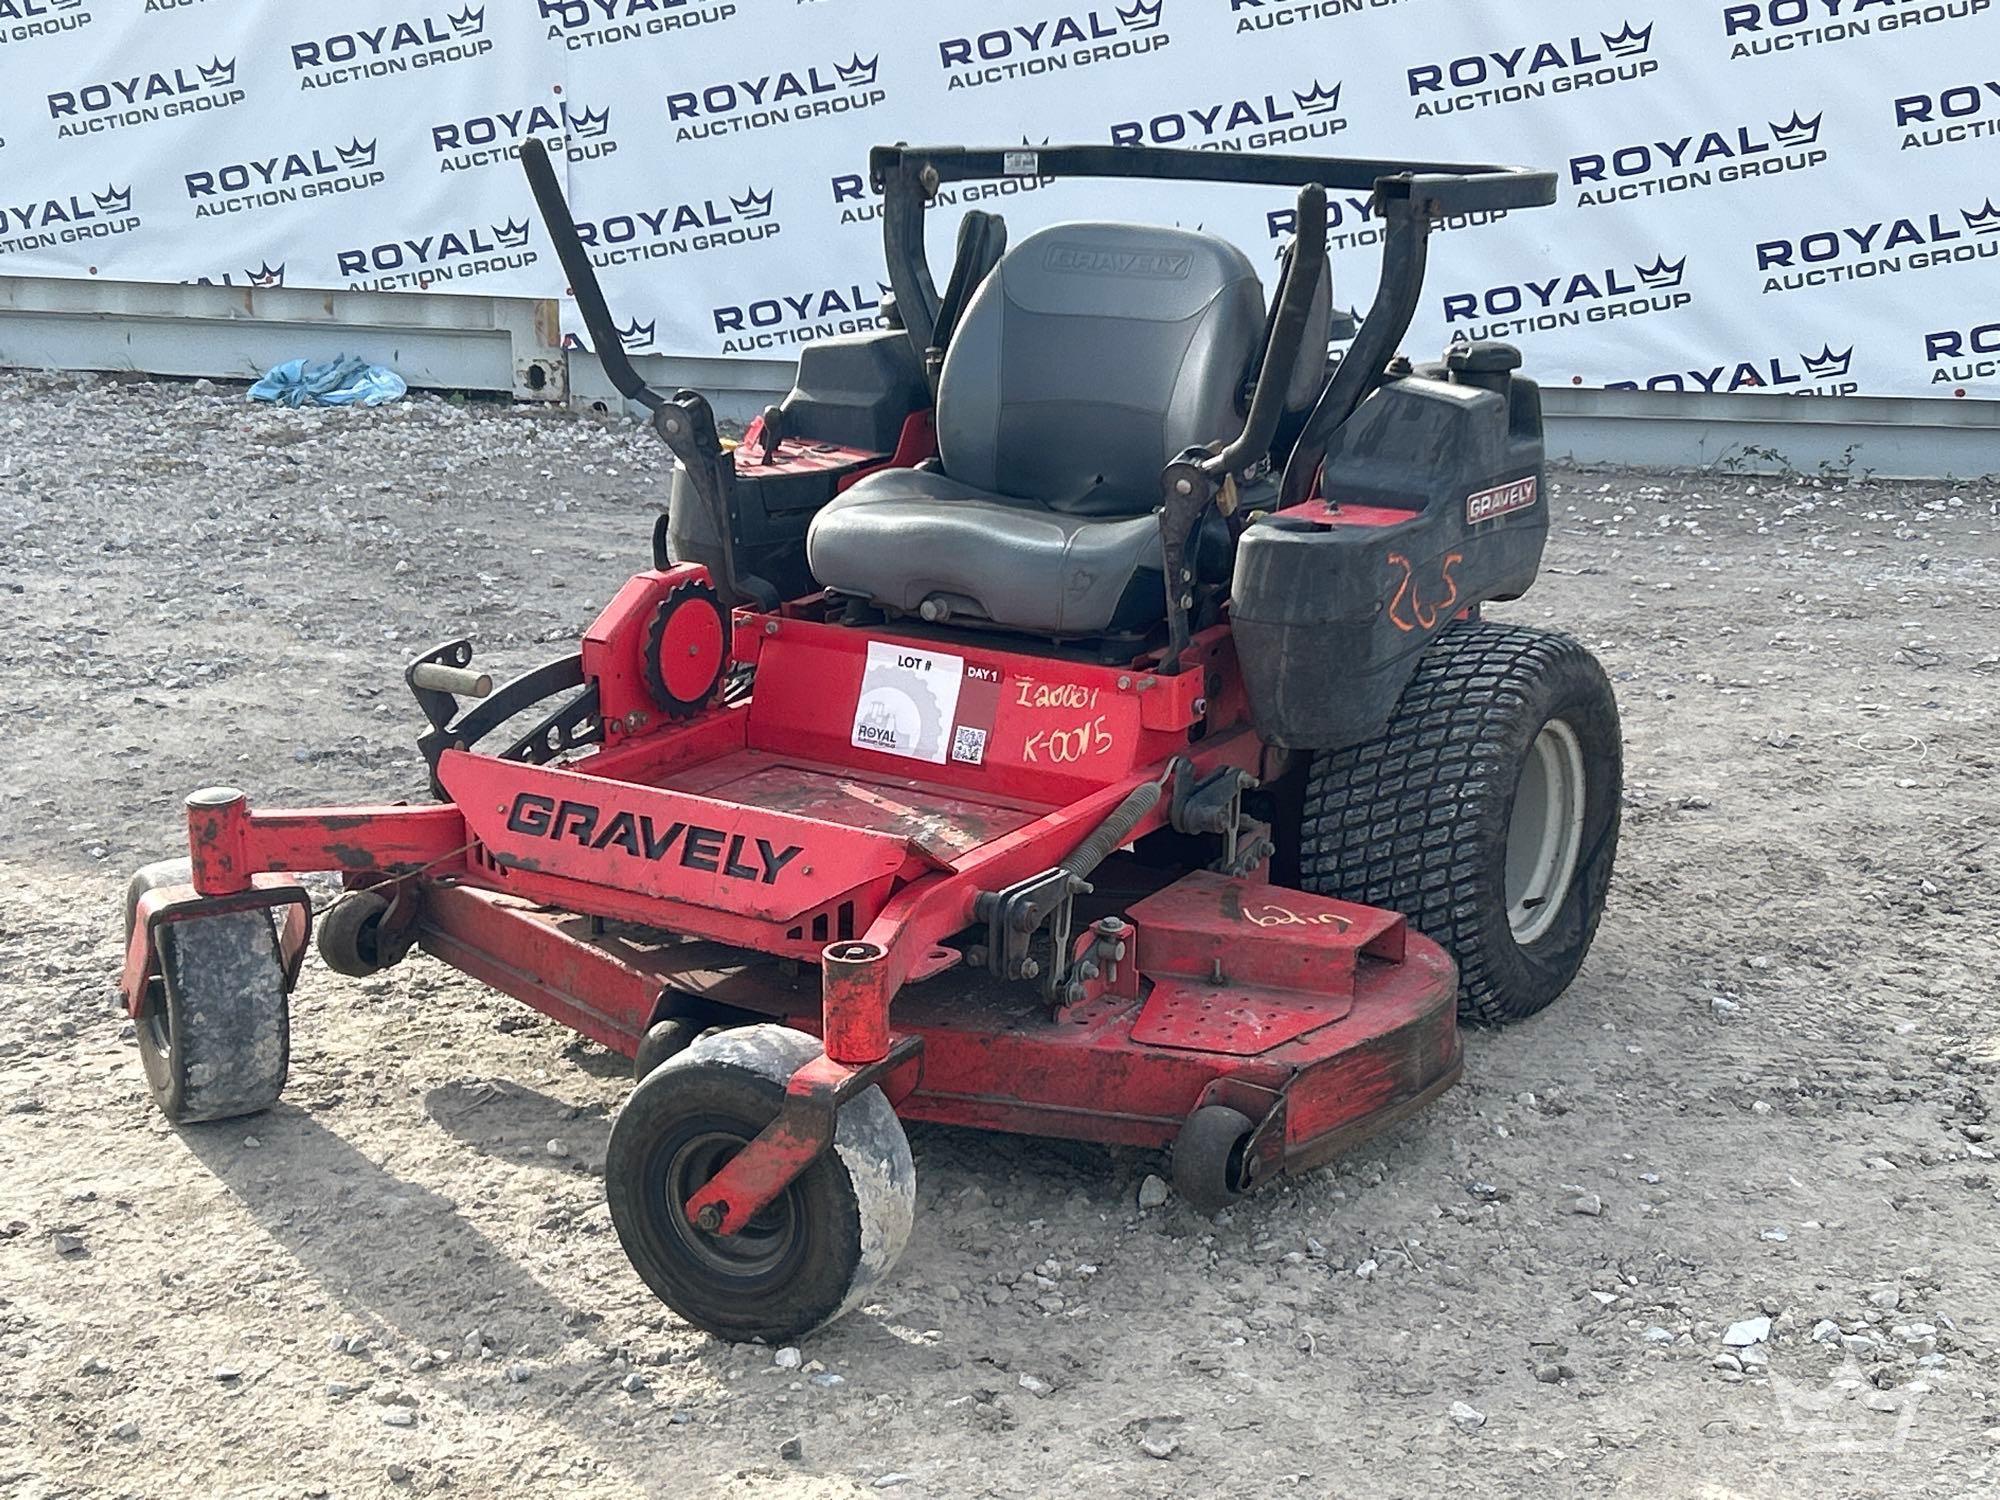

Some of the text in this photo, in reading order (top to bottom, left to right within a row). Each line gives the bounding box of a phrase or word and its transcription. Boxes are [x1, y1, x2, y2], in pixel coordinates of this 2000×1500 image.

[12, 12, 92, 42] GROUP
[647, 3, 736, 34] GROUP
[939, 11, 1117, 68] ROYAL
[1236, 0, 1363, 34] AUCTION
[1730, 0, 1991, 60] AUCTION GROUP
[291, 17, 450, 70] ROYAL
[300, 39, 493, 90] AUCTION GROUP
[948, 33, 1170, 91] AUCTION GROUP
[1407, 37, 1601, 96] ROYAL
[47, 68, 200, 119] ROYAL
[667, 67, 836, 121] ROYAL
[1414, 59, 1659, 119] AUCTION GROUP
[57, 89, 246, 139] AUCTION GROUP
[675, 89, 886, 143] AUCTION GROUP
[1111, 95, 1294, 147] ROYAL
[1248, 118, 1347, 149] GROUP
[1901, 118, 2000, 150] AUCTI
[185, 150, 338, 199] ROYAL
[440, 145, 520, 173] AUCTIO
[1569, 126, 1769, 185] ROYAL
[1577, 149, 1828, 208] AUCTION GROUP
[195, 170, 385, 218] AUCTION GROUP
[962, 175, 1056, 202] GROUP
[0, 196, 95, 234] YAL
[61, 217, 141, 243] GROUP
[573, 200, 732, 249] ROYAL
[337, 229, 494, 276] ROYAL
[588, 223, 781, 269] UCTION GROUP
[1756, 213, 1961, 270] ROYAL
[349, 251, 538, 292] AUCTION GROUP
[1763, 241, 2000, 293] AUCTION GROU
[712, 285, 879, 334] ROYAL
[1443, 268, 1635, 323] ROYAL
[1450, 292, 1692, 345] AUCTION GROUP
[722, 315, 890, 355] AUCTION GRO
[1470, 482, 1533, 518] GRAVELY
[898, 655, 932, 671] LOT #
[967, 666, 998, 682] DAY 1
[858, 725, 896, 743] ROYAL
[506, 792, 804, 885] GRAVELY
